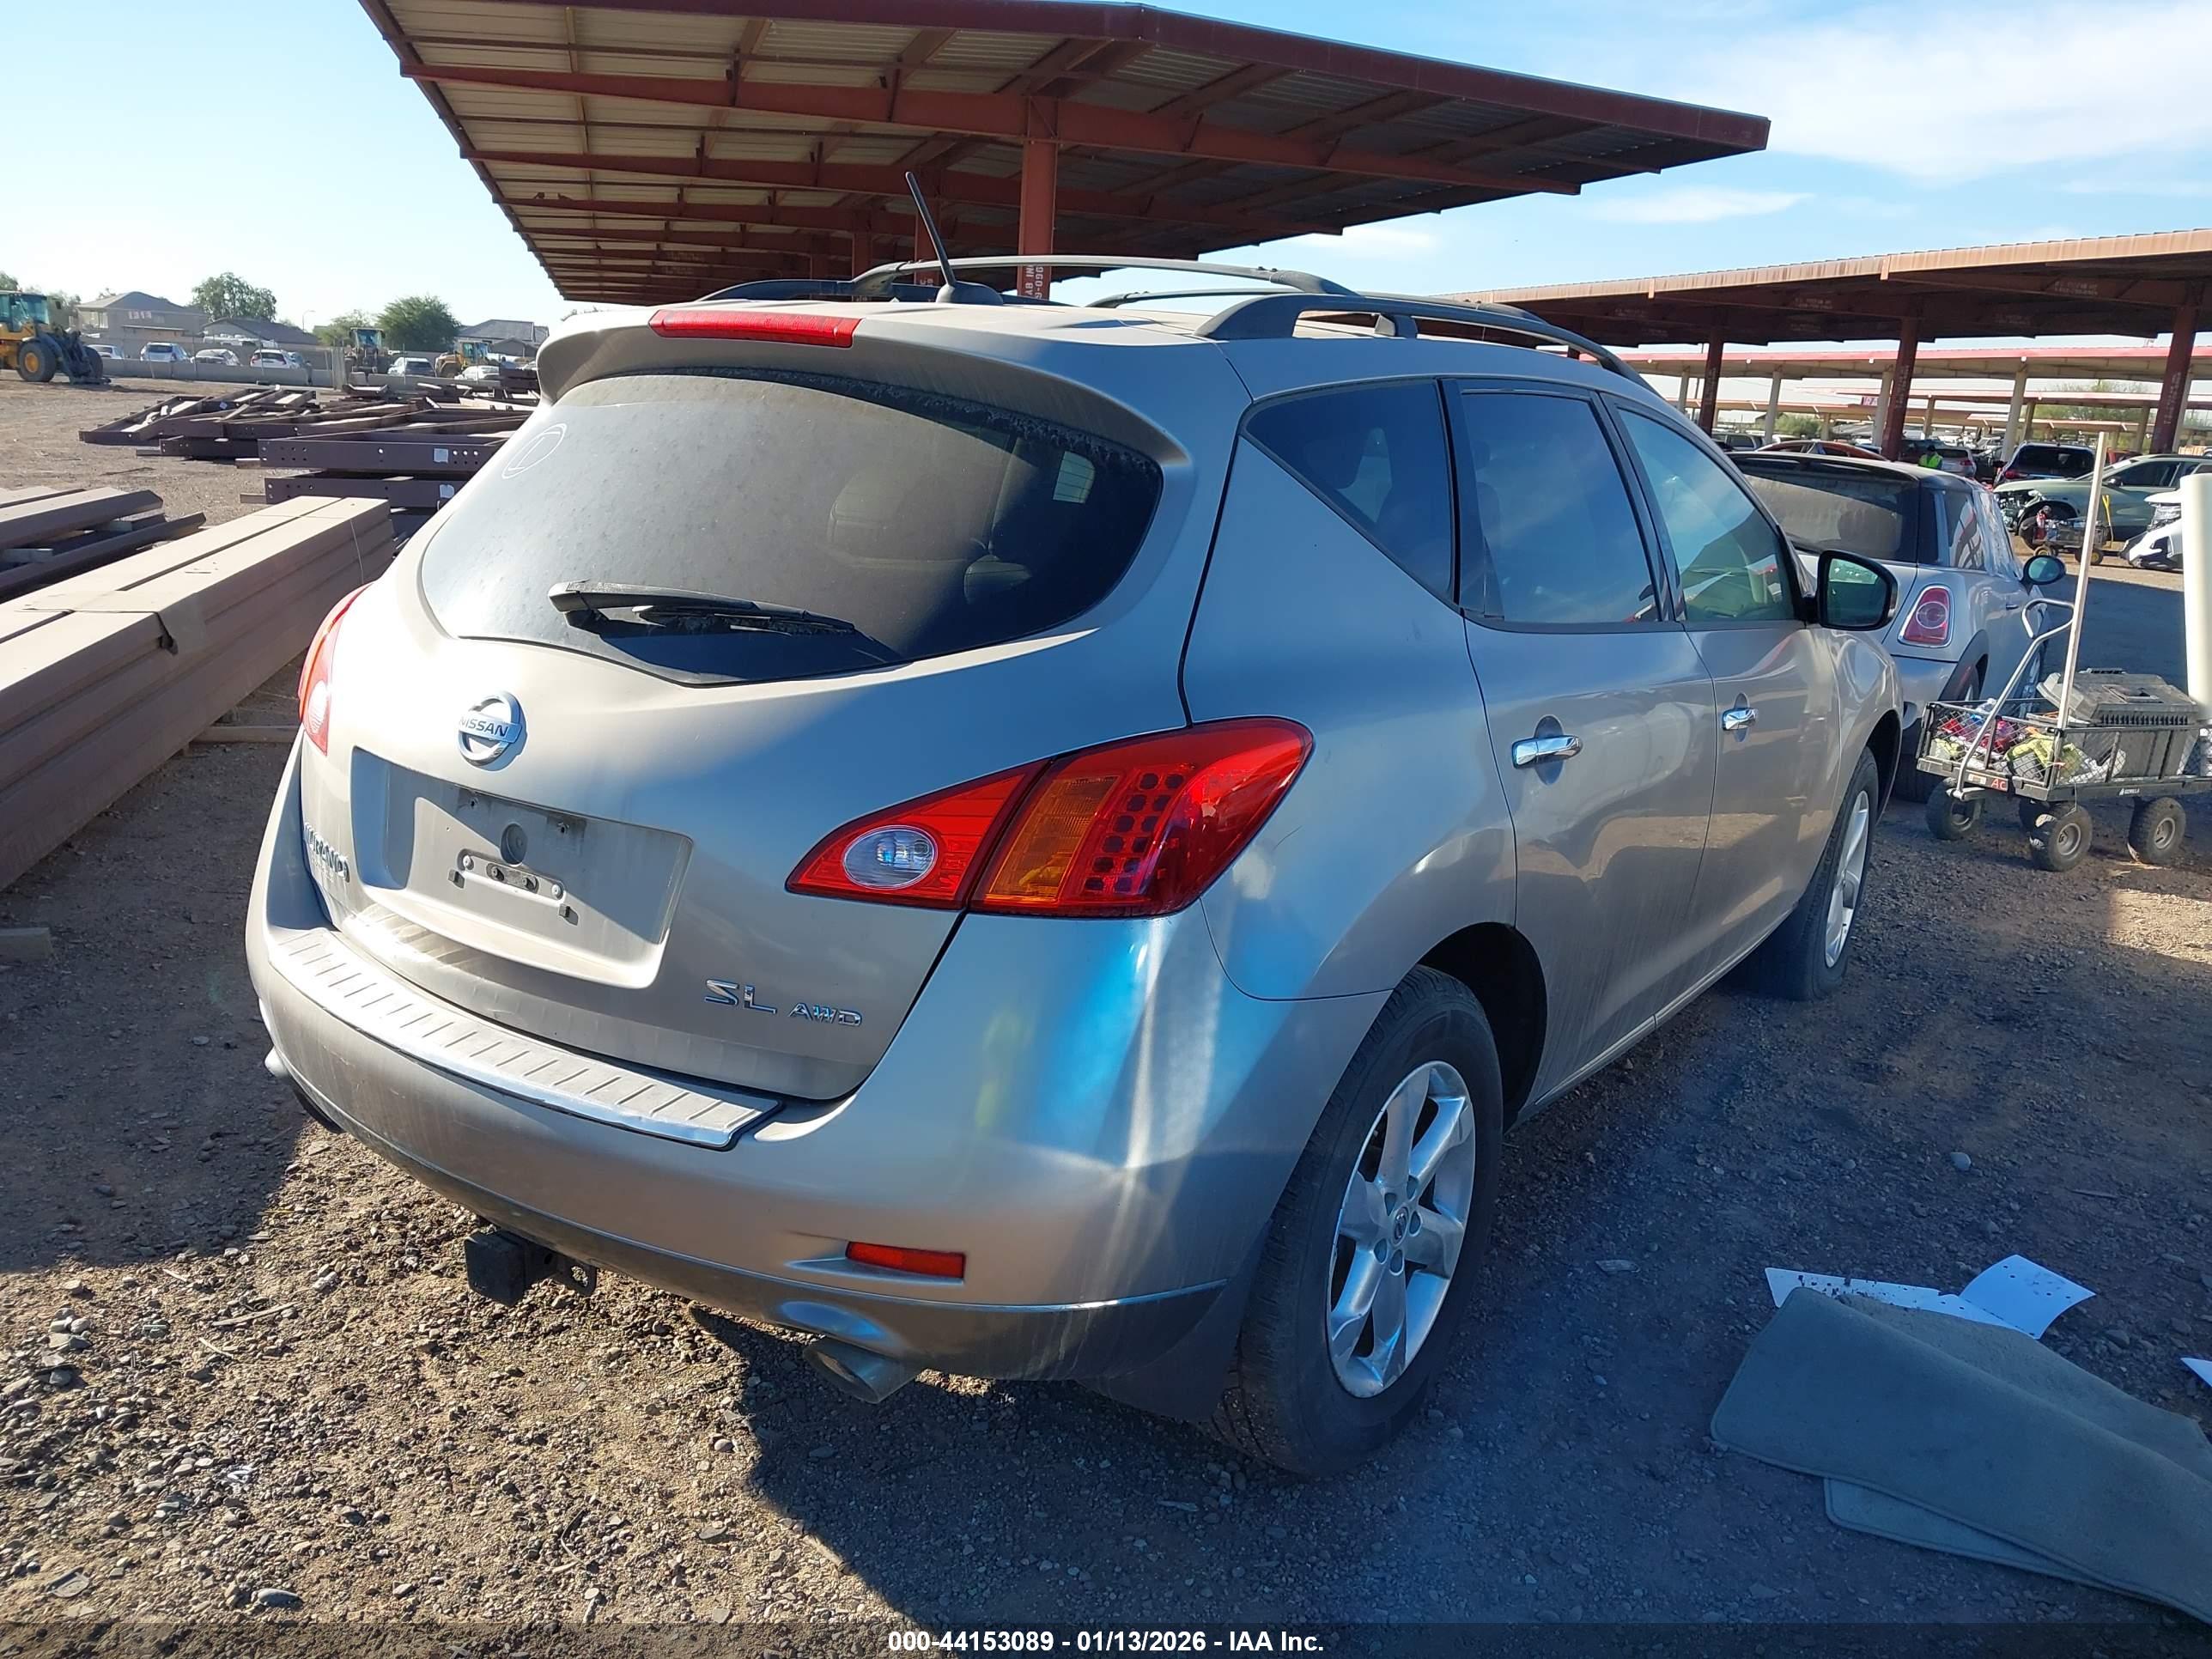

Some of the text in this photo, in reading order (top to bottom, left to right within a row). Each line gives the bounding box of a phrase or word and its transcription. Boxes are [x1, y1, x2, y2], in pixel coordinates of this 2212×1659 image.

[459, 715, 509, 738] NISSAN
[1991, 778, 2008, 791] AC
[703, 978, 863, 1027] SL AWD
